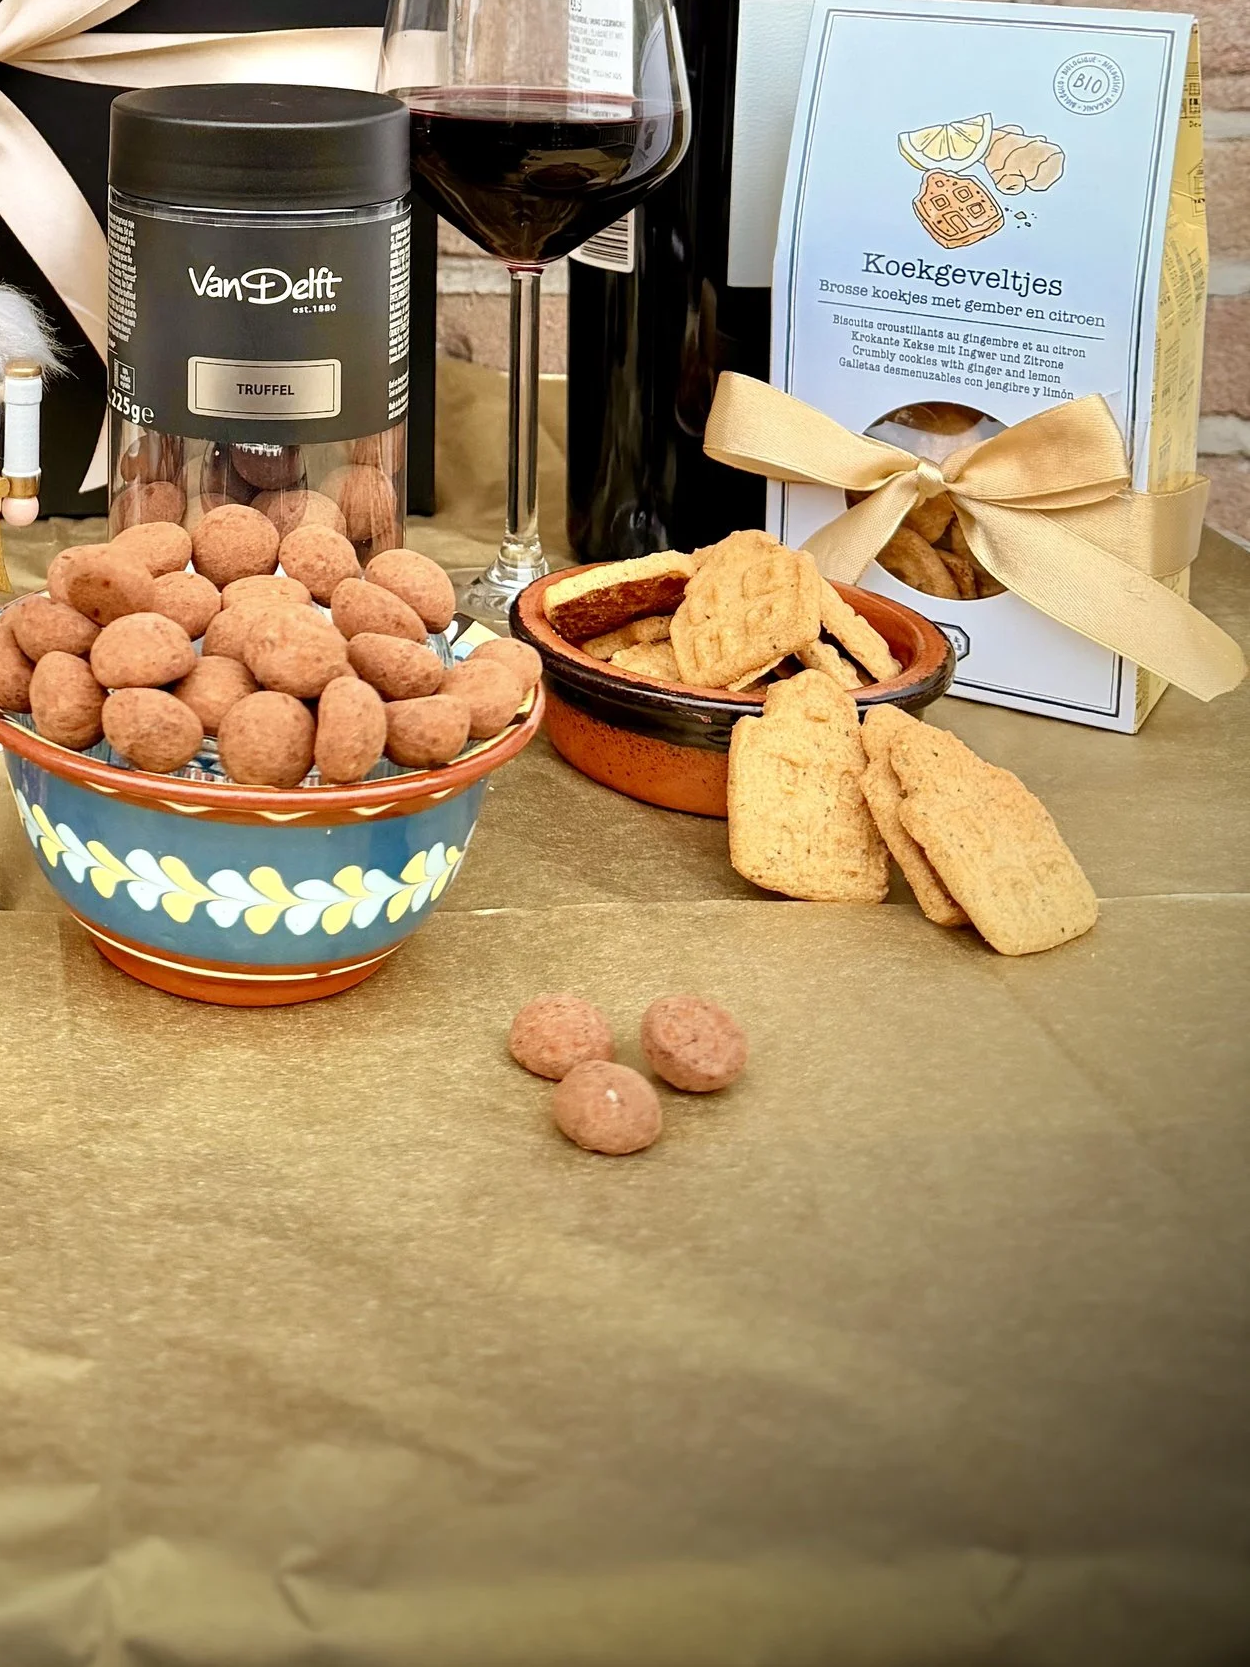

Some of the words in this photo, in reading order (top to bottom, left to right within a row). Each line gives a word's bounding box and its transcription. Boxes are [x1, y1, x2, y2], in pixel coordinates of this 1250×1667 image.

[1072, 73, 1103, 94] BIO
[861, 252, 1063, 298] Koekgeveltjes
[818, 278, 869, 297] Brosse
[871, 285, 929, 306] koekjes
[931, 295, 962, 309] met
[964, 299, 1023, 317] gember
[1025, 308, 1045, 320] en
[1048, 310, 1106, 328] citroen
[832, 314, 874, 329] Biscuits
[876, 322, 944, 340] croustillants
[946, 332, 960, 341] au
[962, 333, 1019, 350] gingembre
[1022, 341, 1034, 351] et
[1035, 343, 1050, 354] au
[1052, 345, 1087, 358] citron
[851, 330, 900, 347] Krokante
[902, 337, 935, 352] Kekse
[937, 344, 956, 355] mit
[958, 345, 998, 361] Ingwer
[999, 353, 1021, 364] und
[1023, 354, 1064, 370] Zitrone
[838, 356, 881, 372] Galletas
[883, 363, 962, 385] desmenuzables
[964, 376, 984, 387] con
[985, 378, 1031, 394] jengibre
[1032, 387, 1041, 397] y
[852, 344, 897, 362] Crumbly
[898, 353, 938, 367] cookies
[940, 358, 965, 371] with
[967, 362, 1003, 376] ginger
[1004, 367, 1026, 379] and
[1028, 370, 1062, 384] lemon
[236, 383, 295, 396] TRUFFEL
